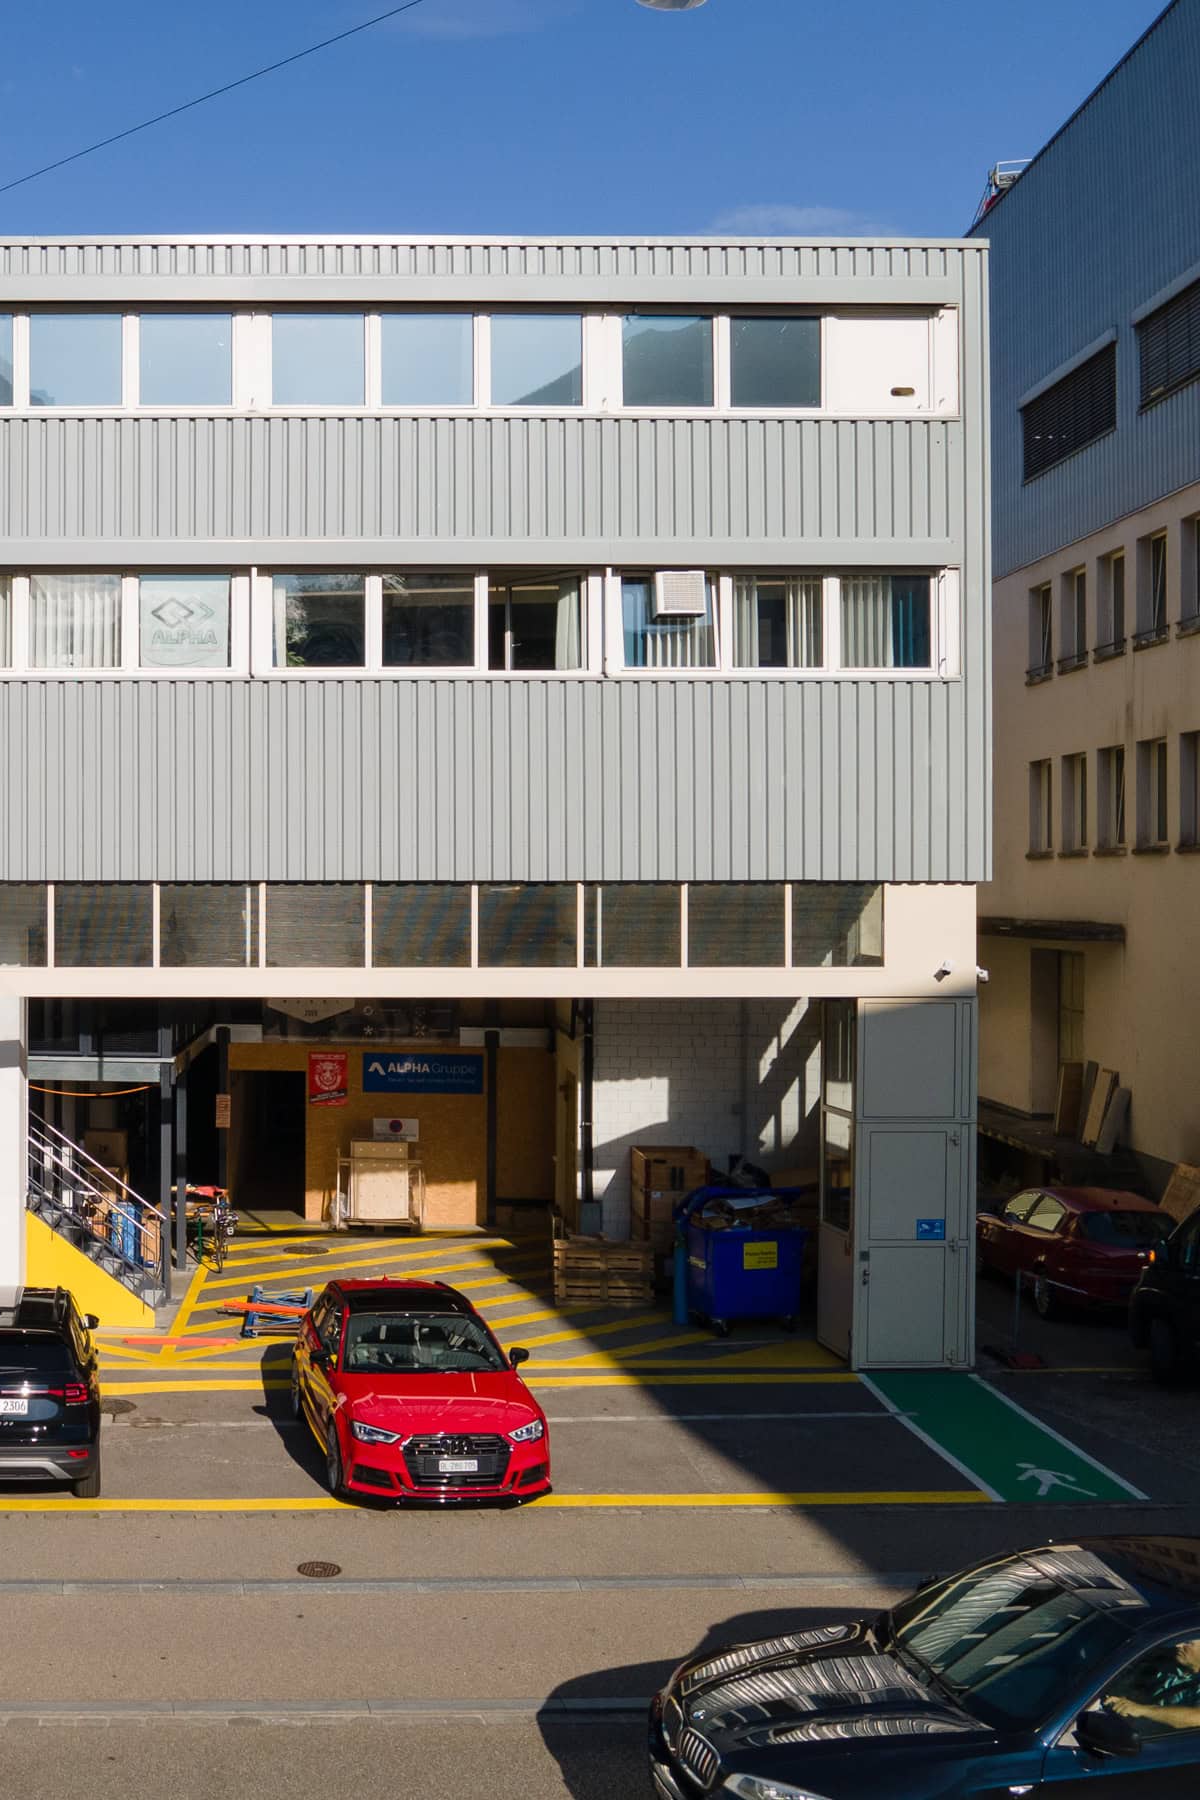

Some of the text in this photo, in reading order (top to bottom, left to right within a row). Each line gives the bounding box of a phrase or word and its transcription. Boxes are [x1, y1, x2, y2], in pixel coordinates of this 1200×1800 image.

[151, 630, 217, 645] ALPHA
[388, 1062, 476, 1077] ALPHA Gruppe
[3, 1401, 26, 1412] 2306
